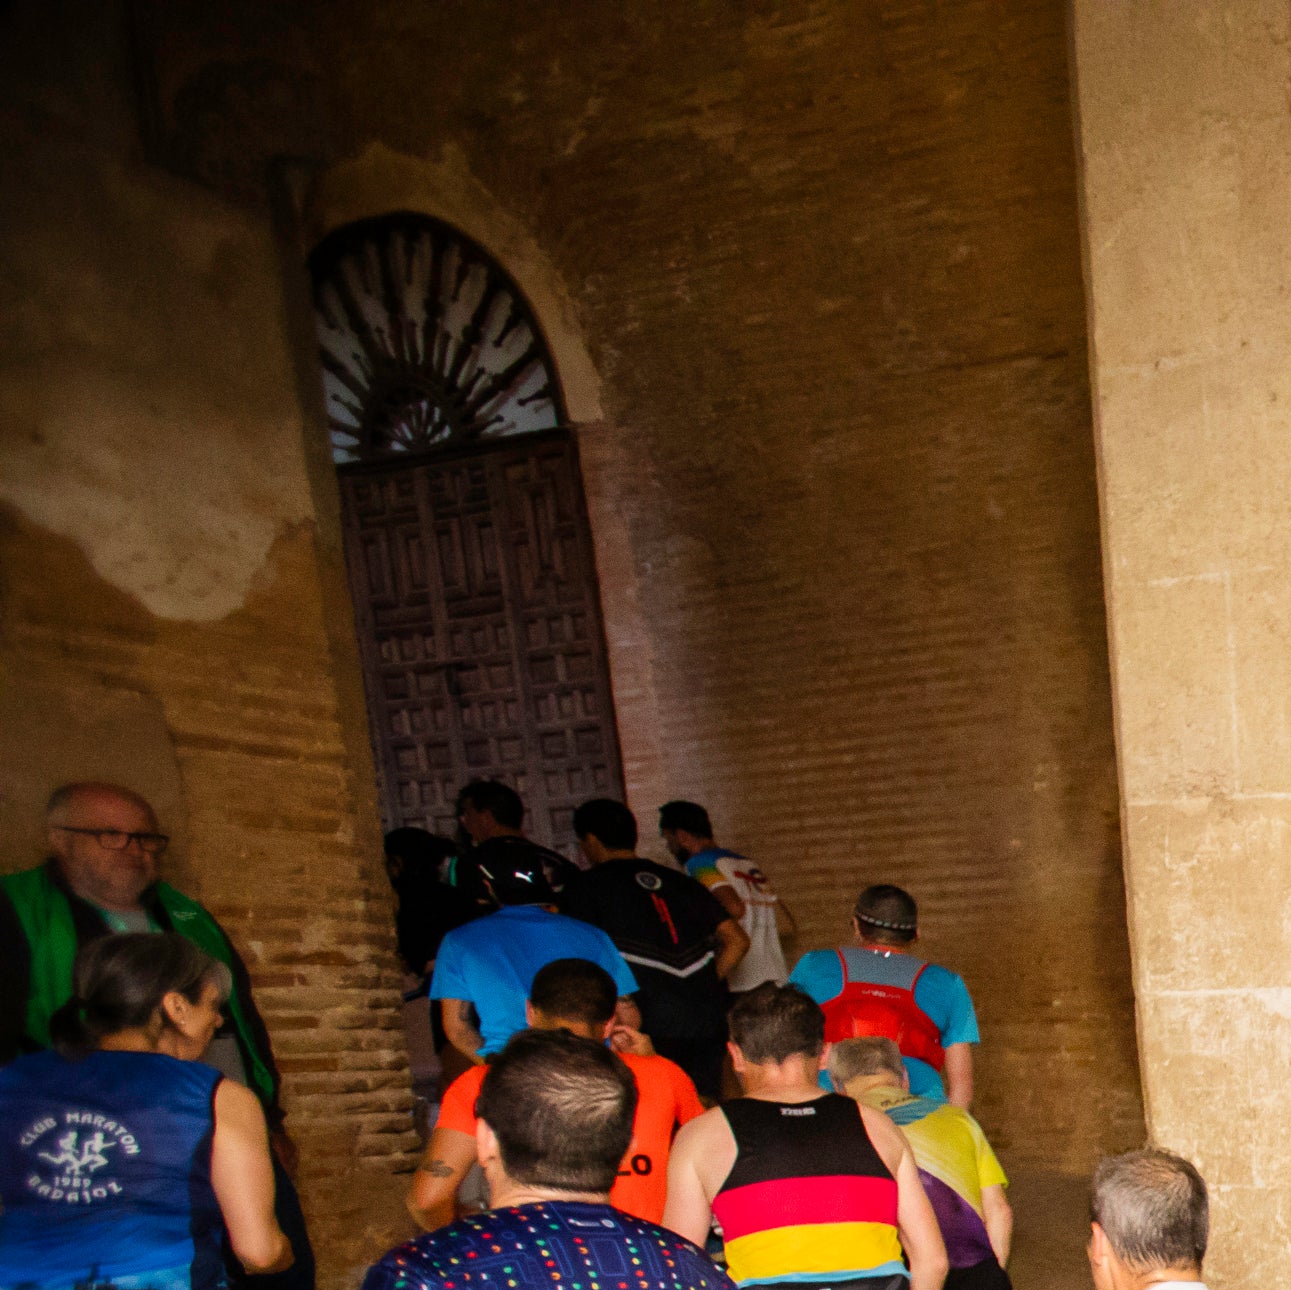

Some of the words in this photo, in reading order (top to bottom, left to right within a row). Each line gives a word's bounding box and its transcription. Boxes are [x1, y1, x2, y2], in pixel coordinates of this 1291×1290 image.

[21, 1118, 57, 1145] CLUB
[65, 1112, 140, 1154] MARATON
[28, 1175, 122, 1203] BADAJOZ
